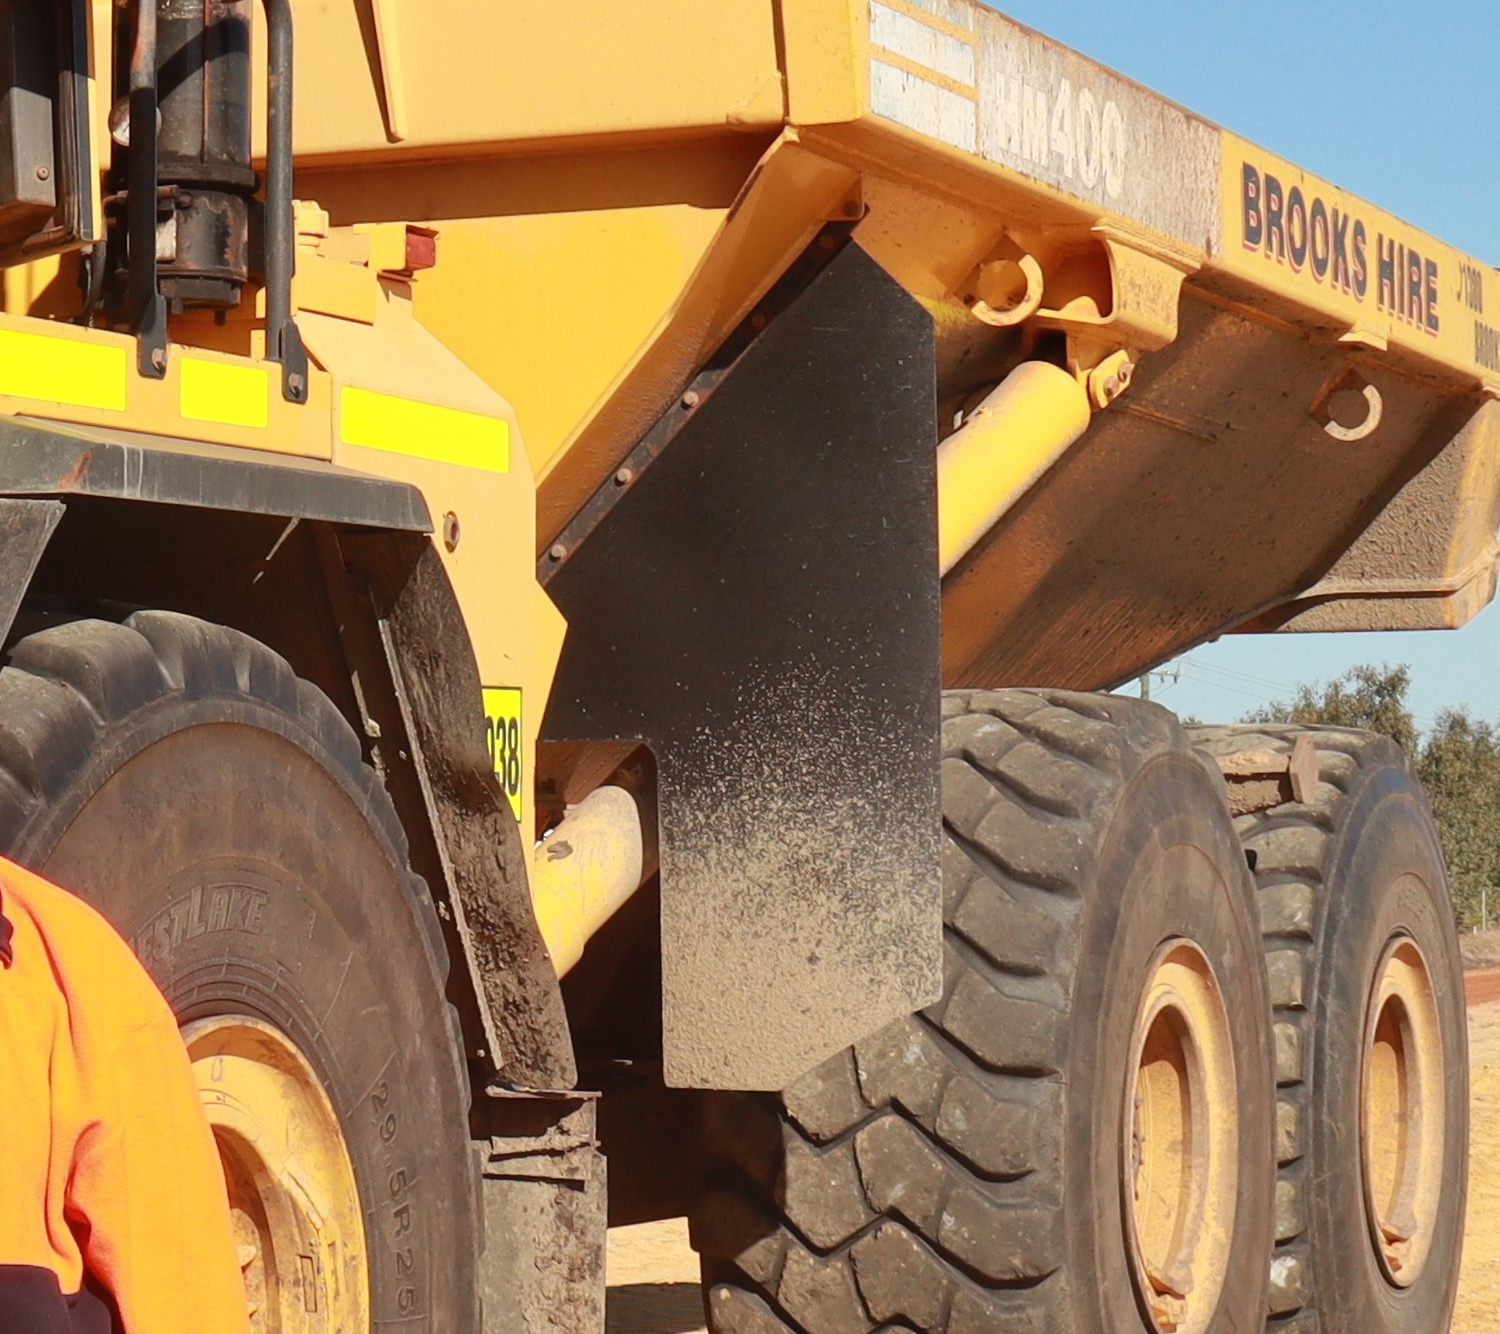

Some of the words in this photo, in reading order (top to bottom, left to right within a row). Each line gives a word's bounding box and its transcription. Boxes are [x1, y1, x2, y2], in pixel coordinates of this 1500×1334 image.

[996, 72, 1125, 199] HM400
[1241, 161, 1368, 304] BROOKS
[1376, 232, 1440, 338] HIRE
[131, 885, 269, 963] ESTLAKE
